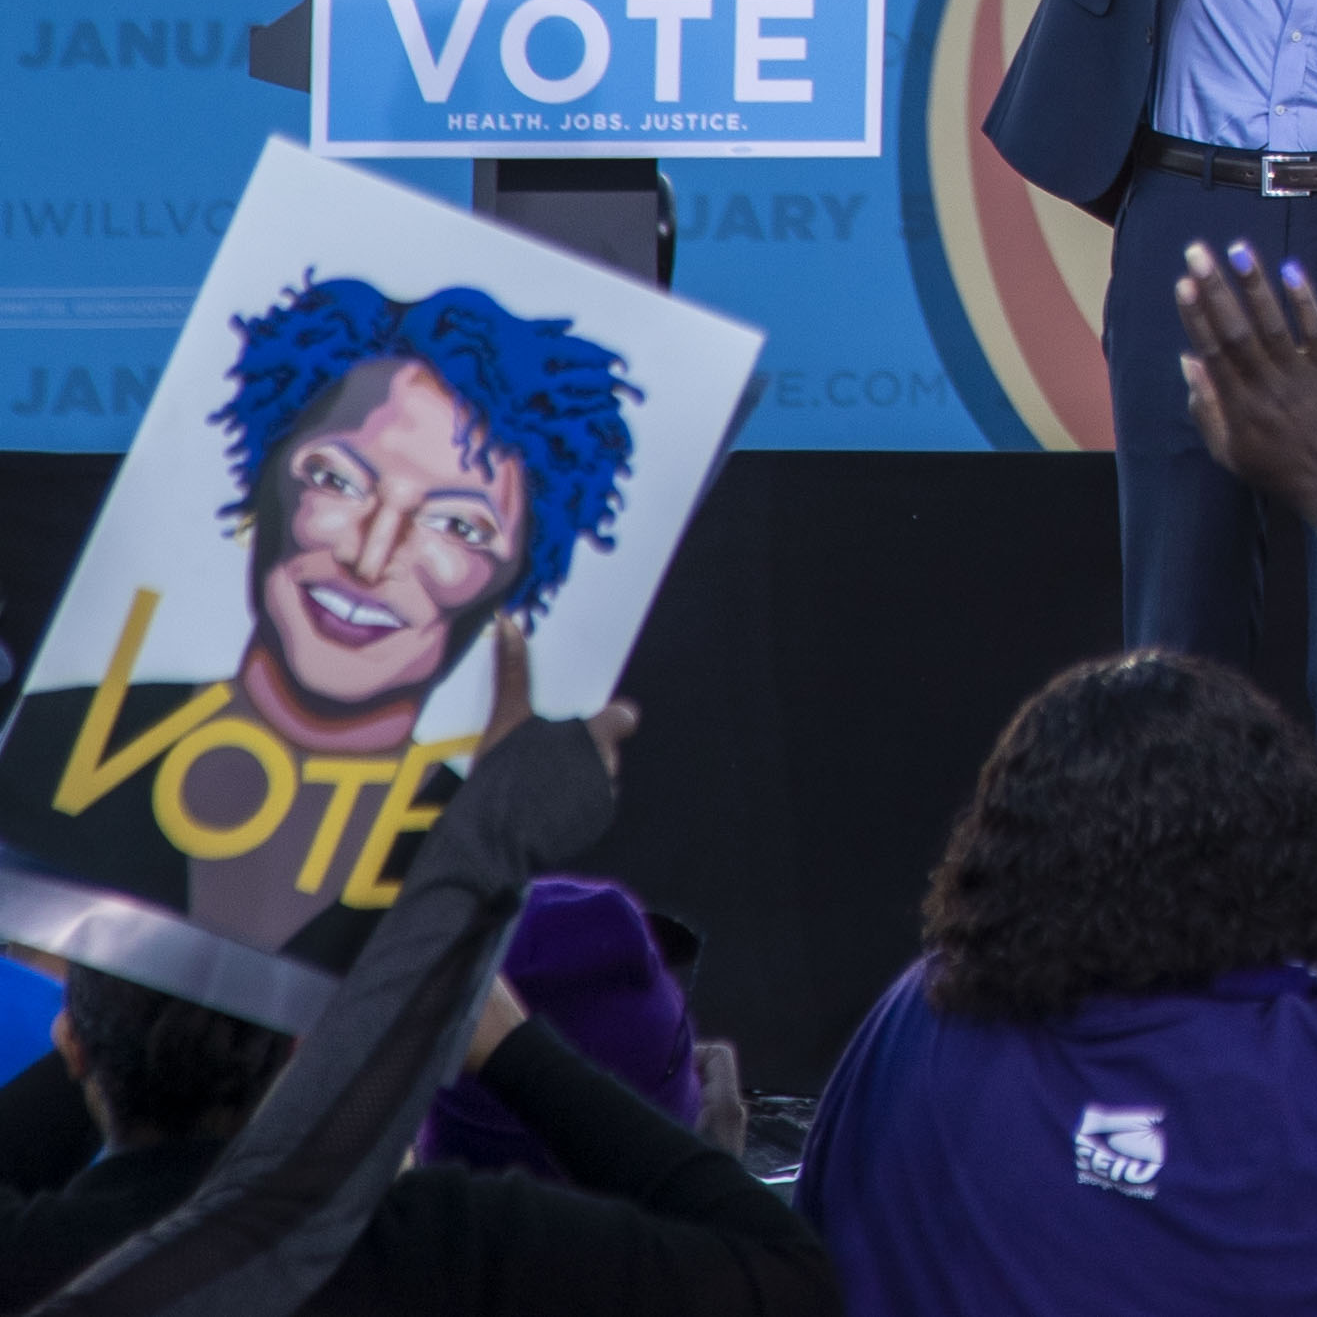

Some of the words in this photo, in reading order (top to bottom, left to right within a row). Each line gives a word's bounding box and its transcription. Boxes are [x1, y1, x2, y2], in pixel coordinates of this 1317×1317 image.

[447, 114, 550, 132] HEALTH.
[559, 114, 631, 132] JOBS.
[640, 114, 749, 132] JUSTICE.
[52, 586, 487, 910] VOTE
